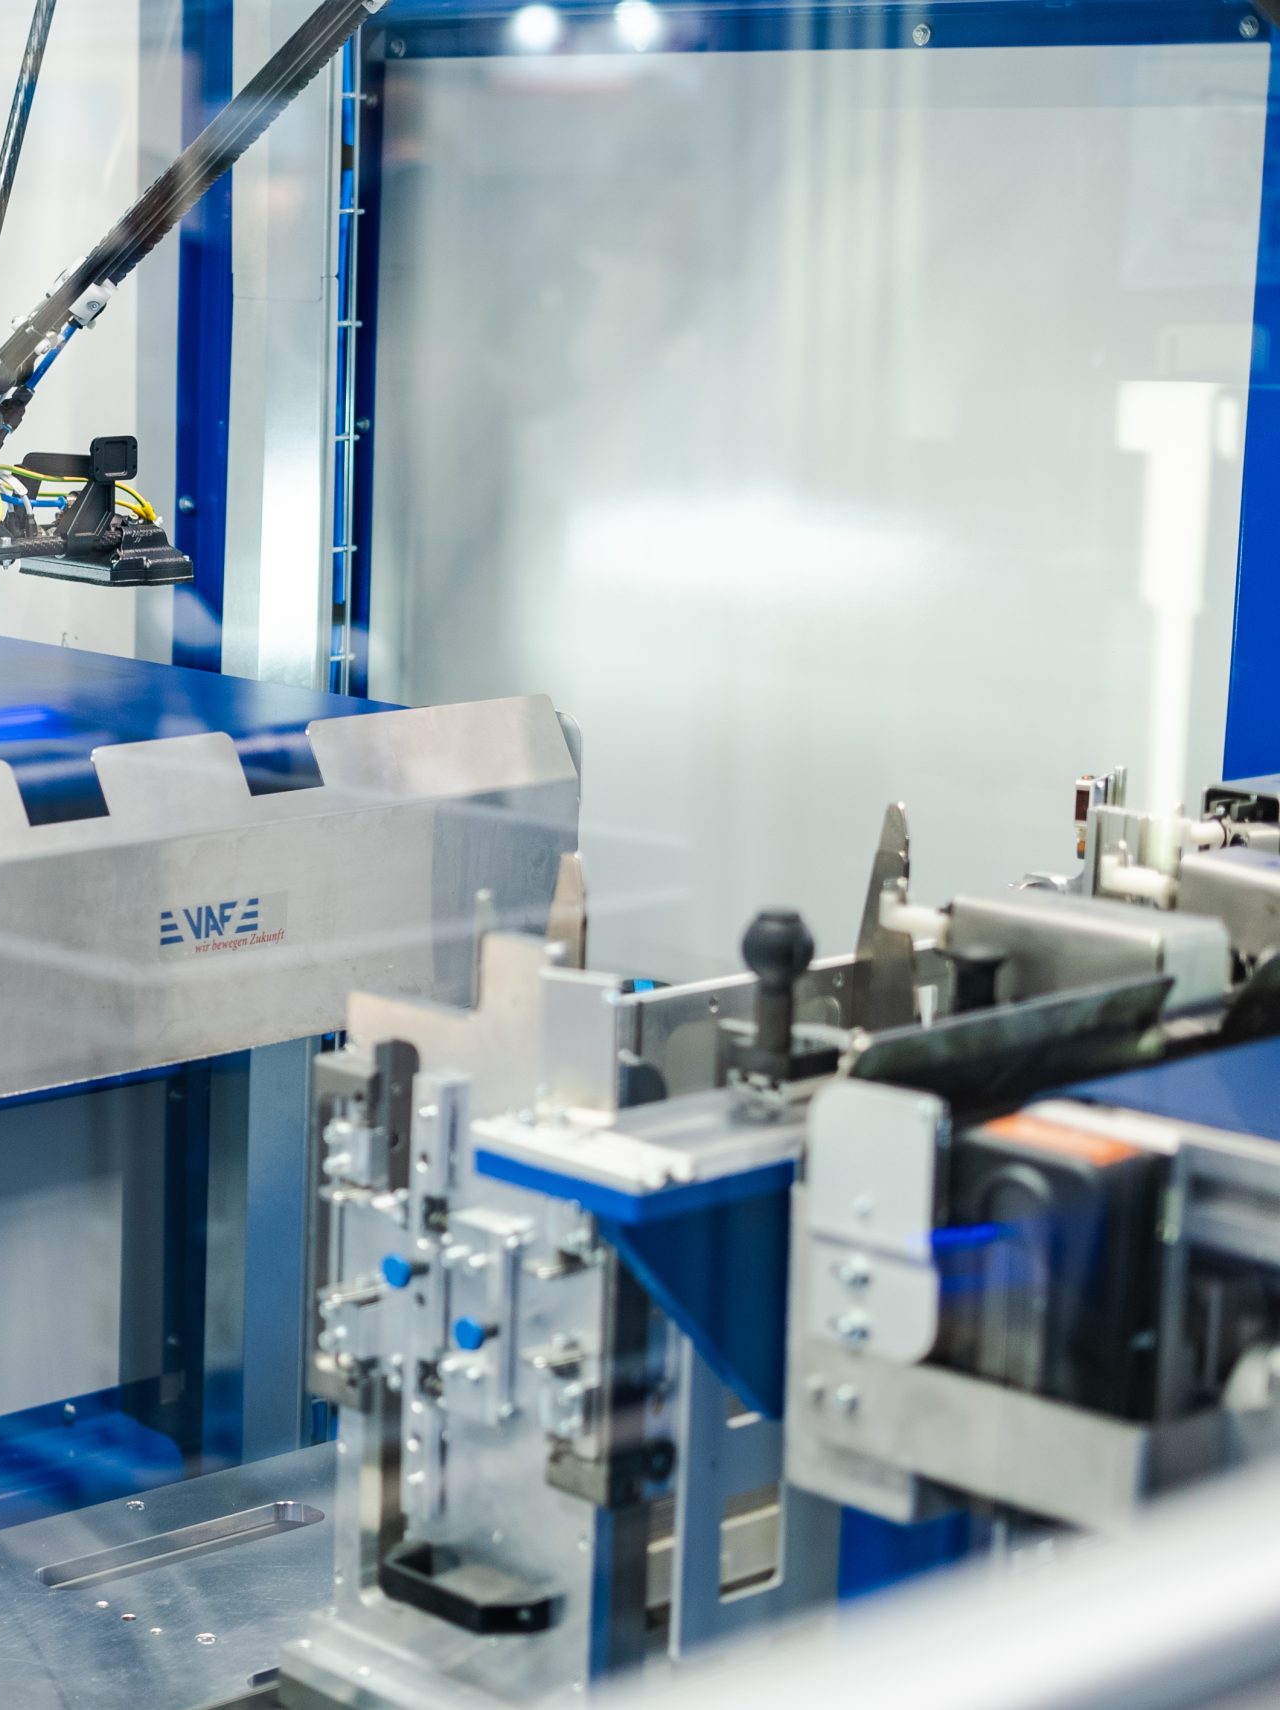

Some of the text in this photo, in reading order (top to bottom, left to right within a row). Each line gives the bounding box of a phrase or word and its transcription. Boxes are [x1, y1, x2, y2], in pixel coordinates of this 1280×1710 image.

[195, 928, 285, 953] wir bewegen Zukunft
